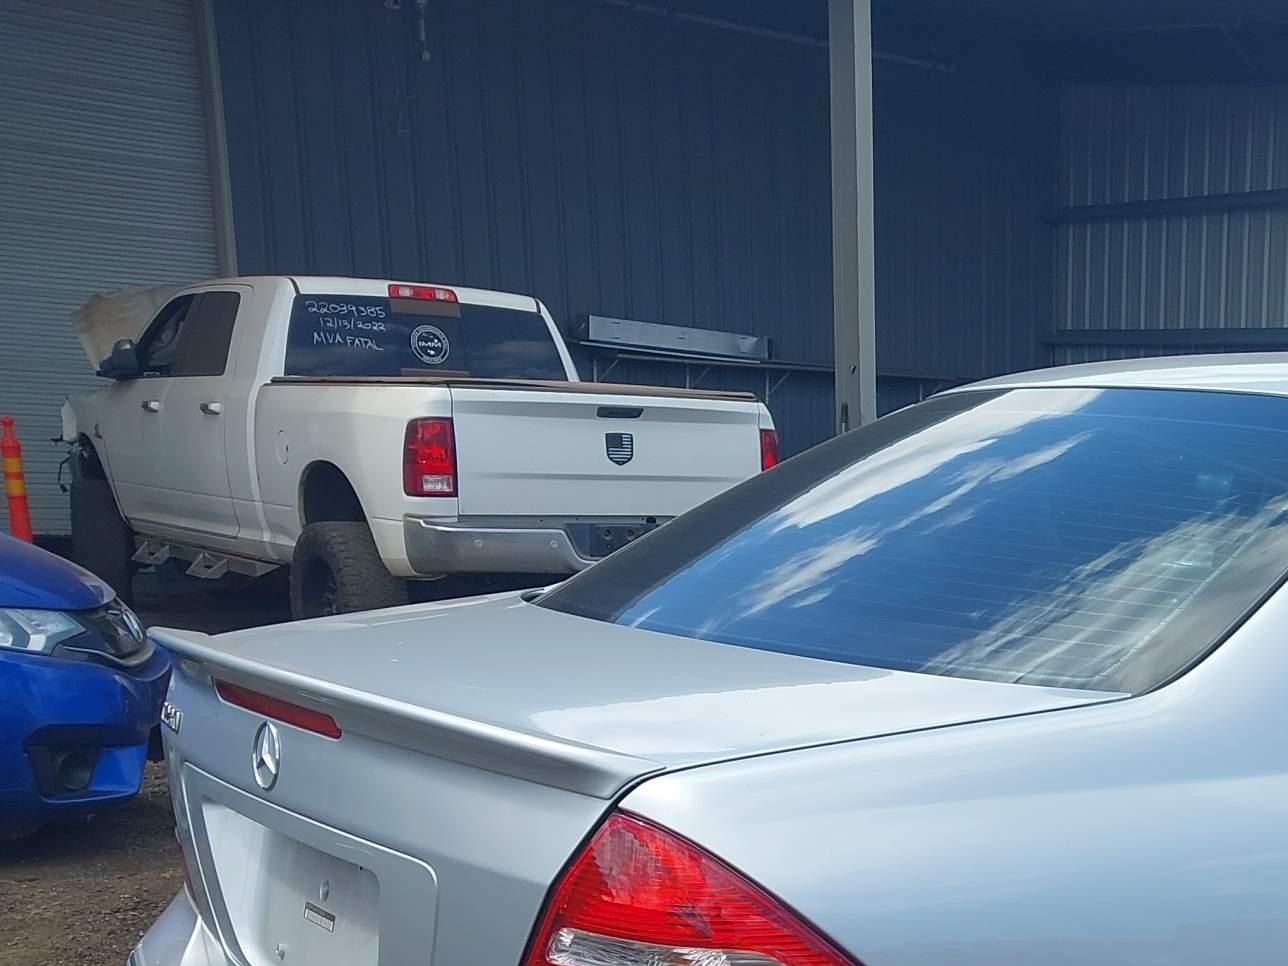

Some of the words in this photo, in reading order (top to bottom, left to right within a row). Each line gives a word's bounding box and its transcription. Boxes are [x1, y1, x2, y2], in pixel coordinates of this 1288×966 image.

[319, 316, 386, 332] 12/13/2022
[313, 331, 344, 345] MVA
[346, 336, 385, 351] FATAL
